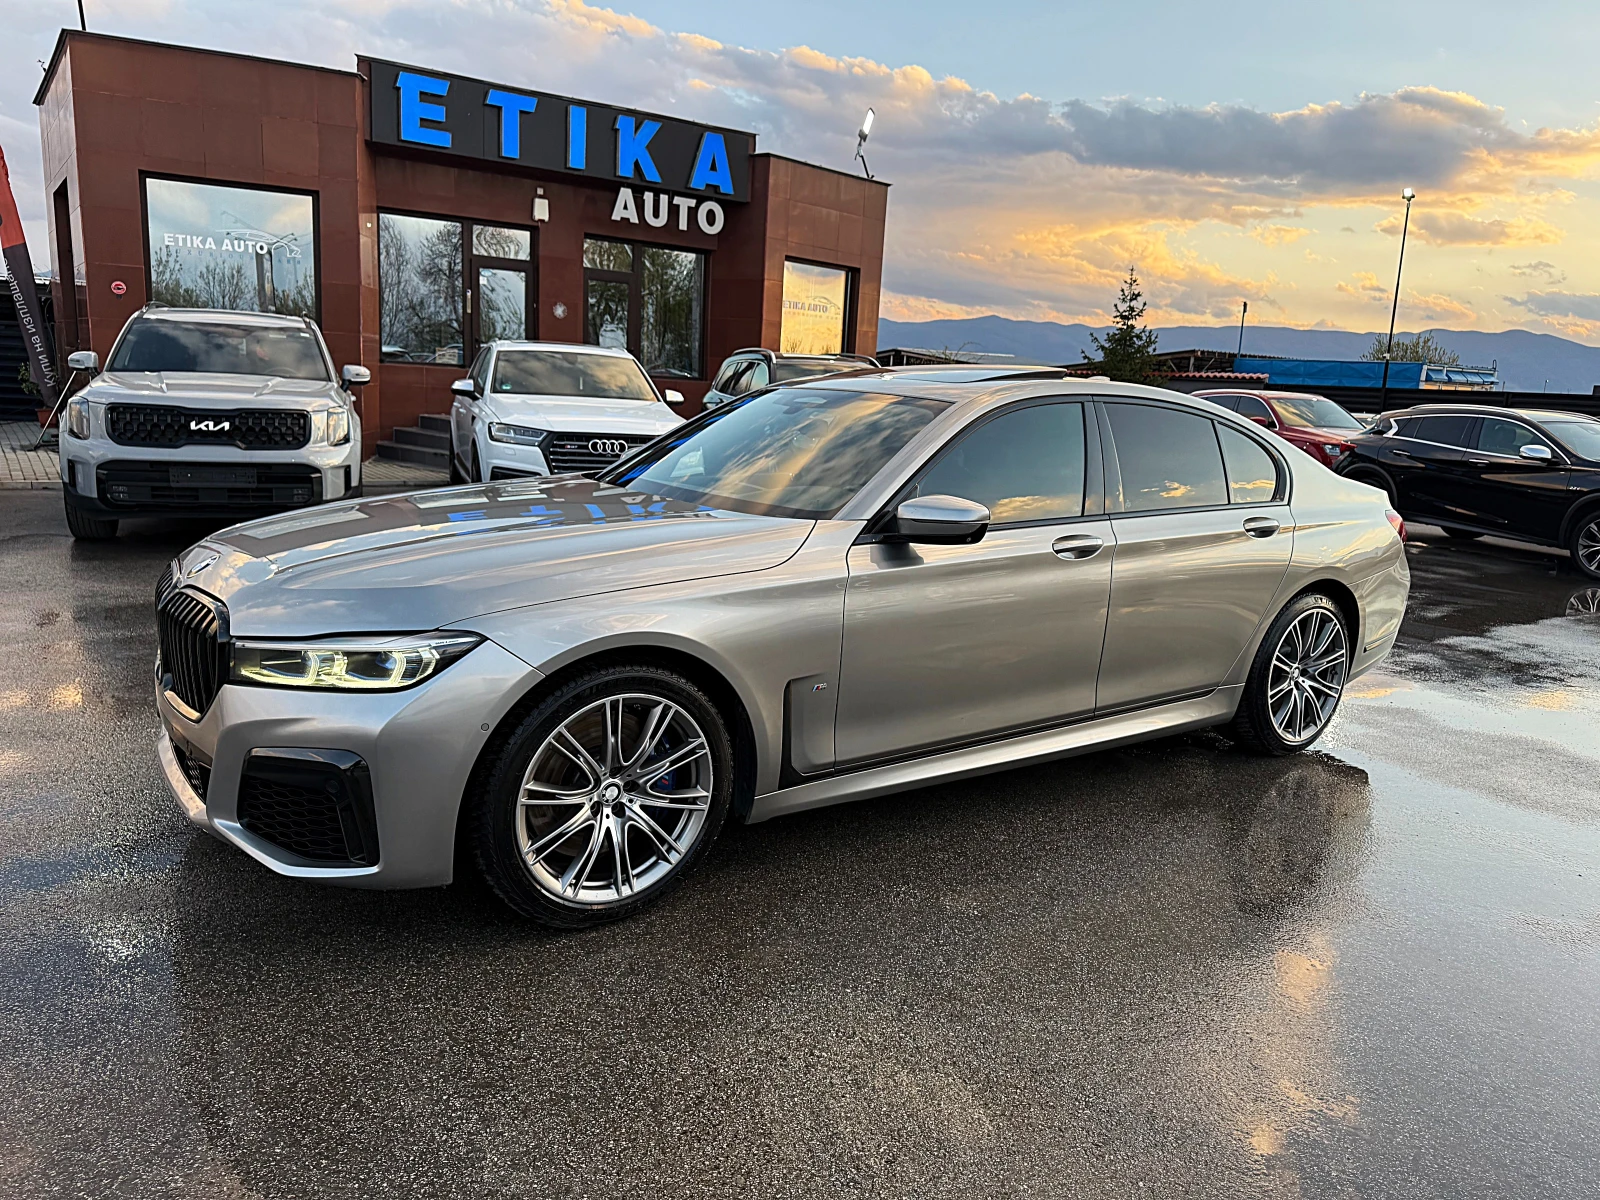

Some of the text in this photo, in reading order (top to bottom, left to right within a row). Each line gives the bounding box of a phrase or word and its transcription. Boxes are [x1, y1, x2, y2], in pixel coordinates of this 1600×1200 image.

[395, 71, 735, 195] ETIKA
[611, 187, 725, 235] AUTO
[163, 233, 268, 254] ETIKA AUTO
[807, 303, 828, 313] AUTO
[31, 335, 44, 353] на
[38, 354, 56, 387] Купи
[190, 420, 230, 431] KIA
